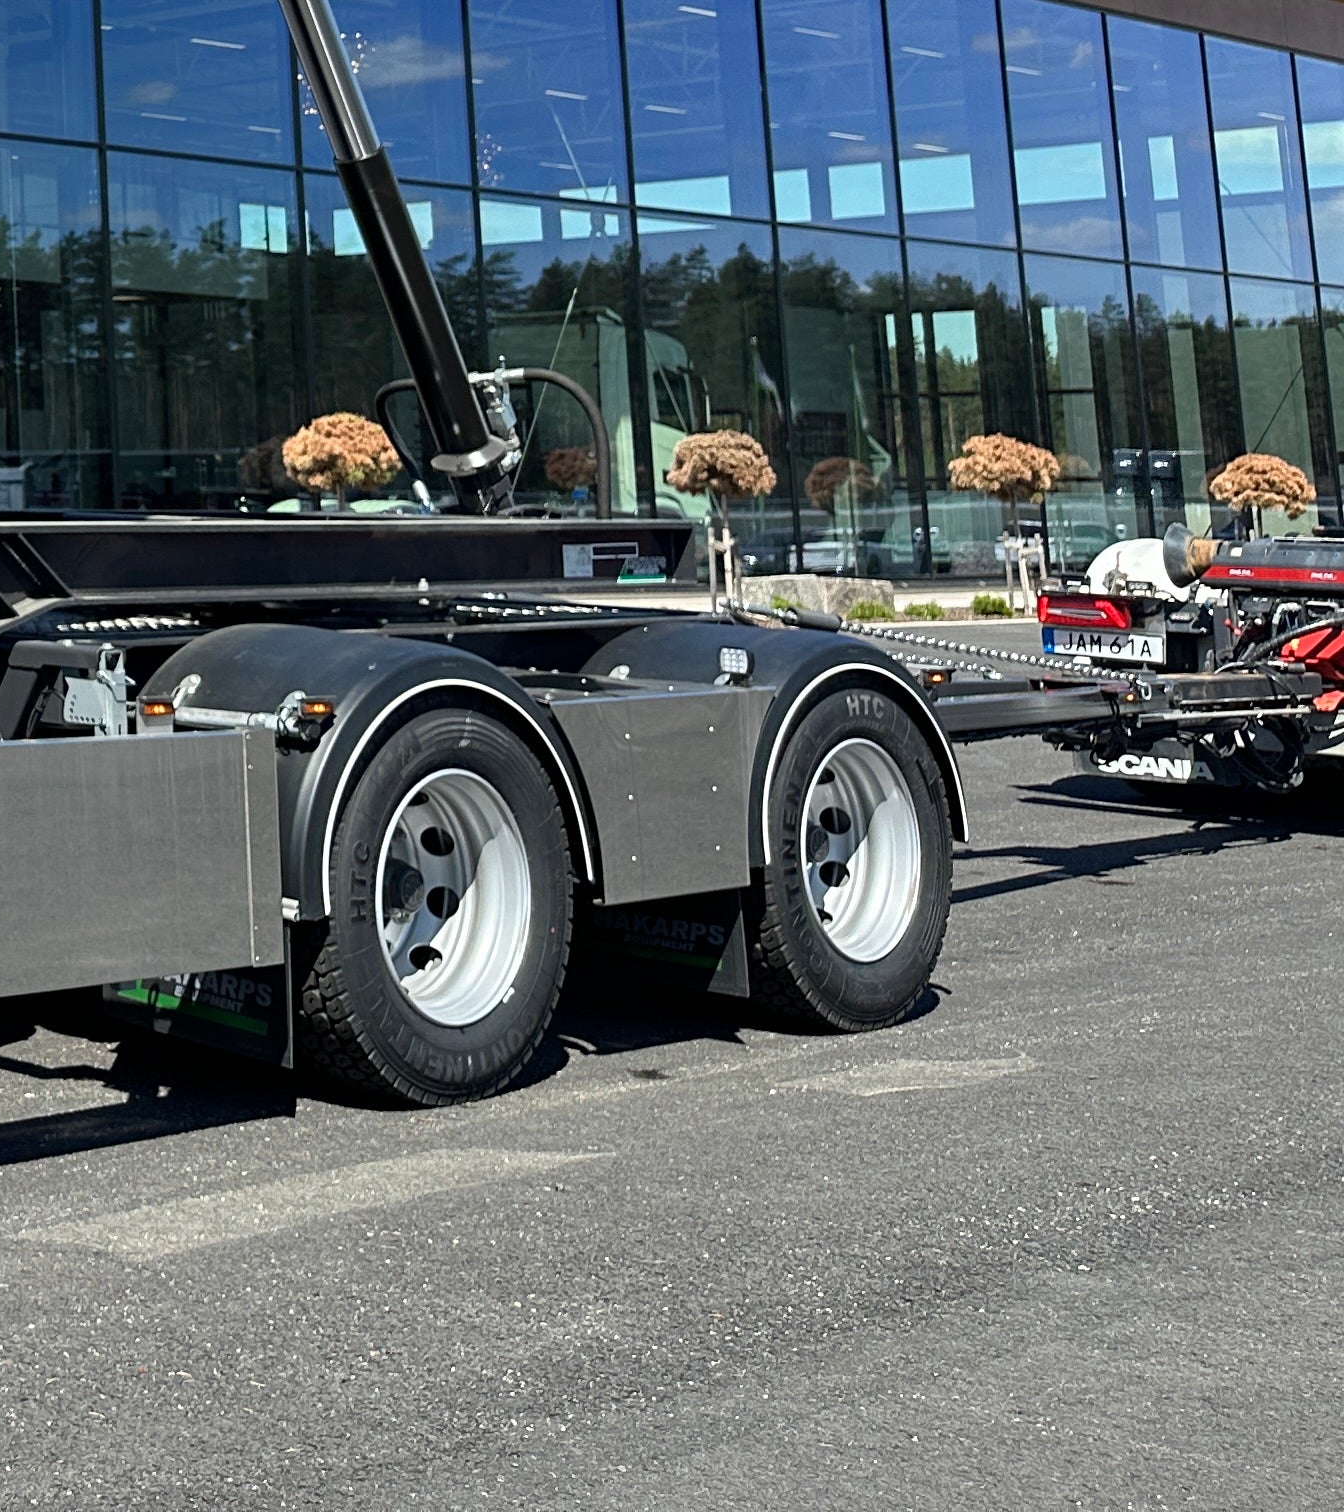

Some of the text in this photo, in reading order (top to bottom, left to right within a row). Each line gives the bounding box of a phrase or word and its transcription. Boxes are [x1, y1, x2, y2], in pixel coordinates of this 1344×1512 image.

[1063, 632, 1152, 658] JAM 61A
[845, 693, 885, 719] HTC
[1098, 754, 1216, 782] SCANIA
[351, 840, 371, 924] HTC
[594, 909, 725, 946] HAKARPS
